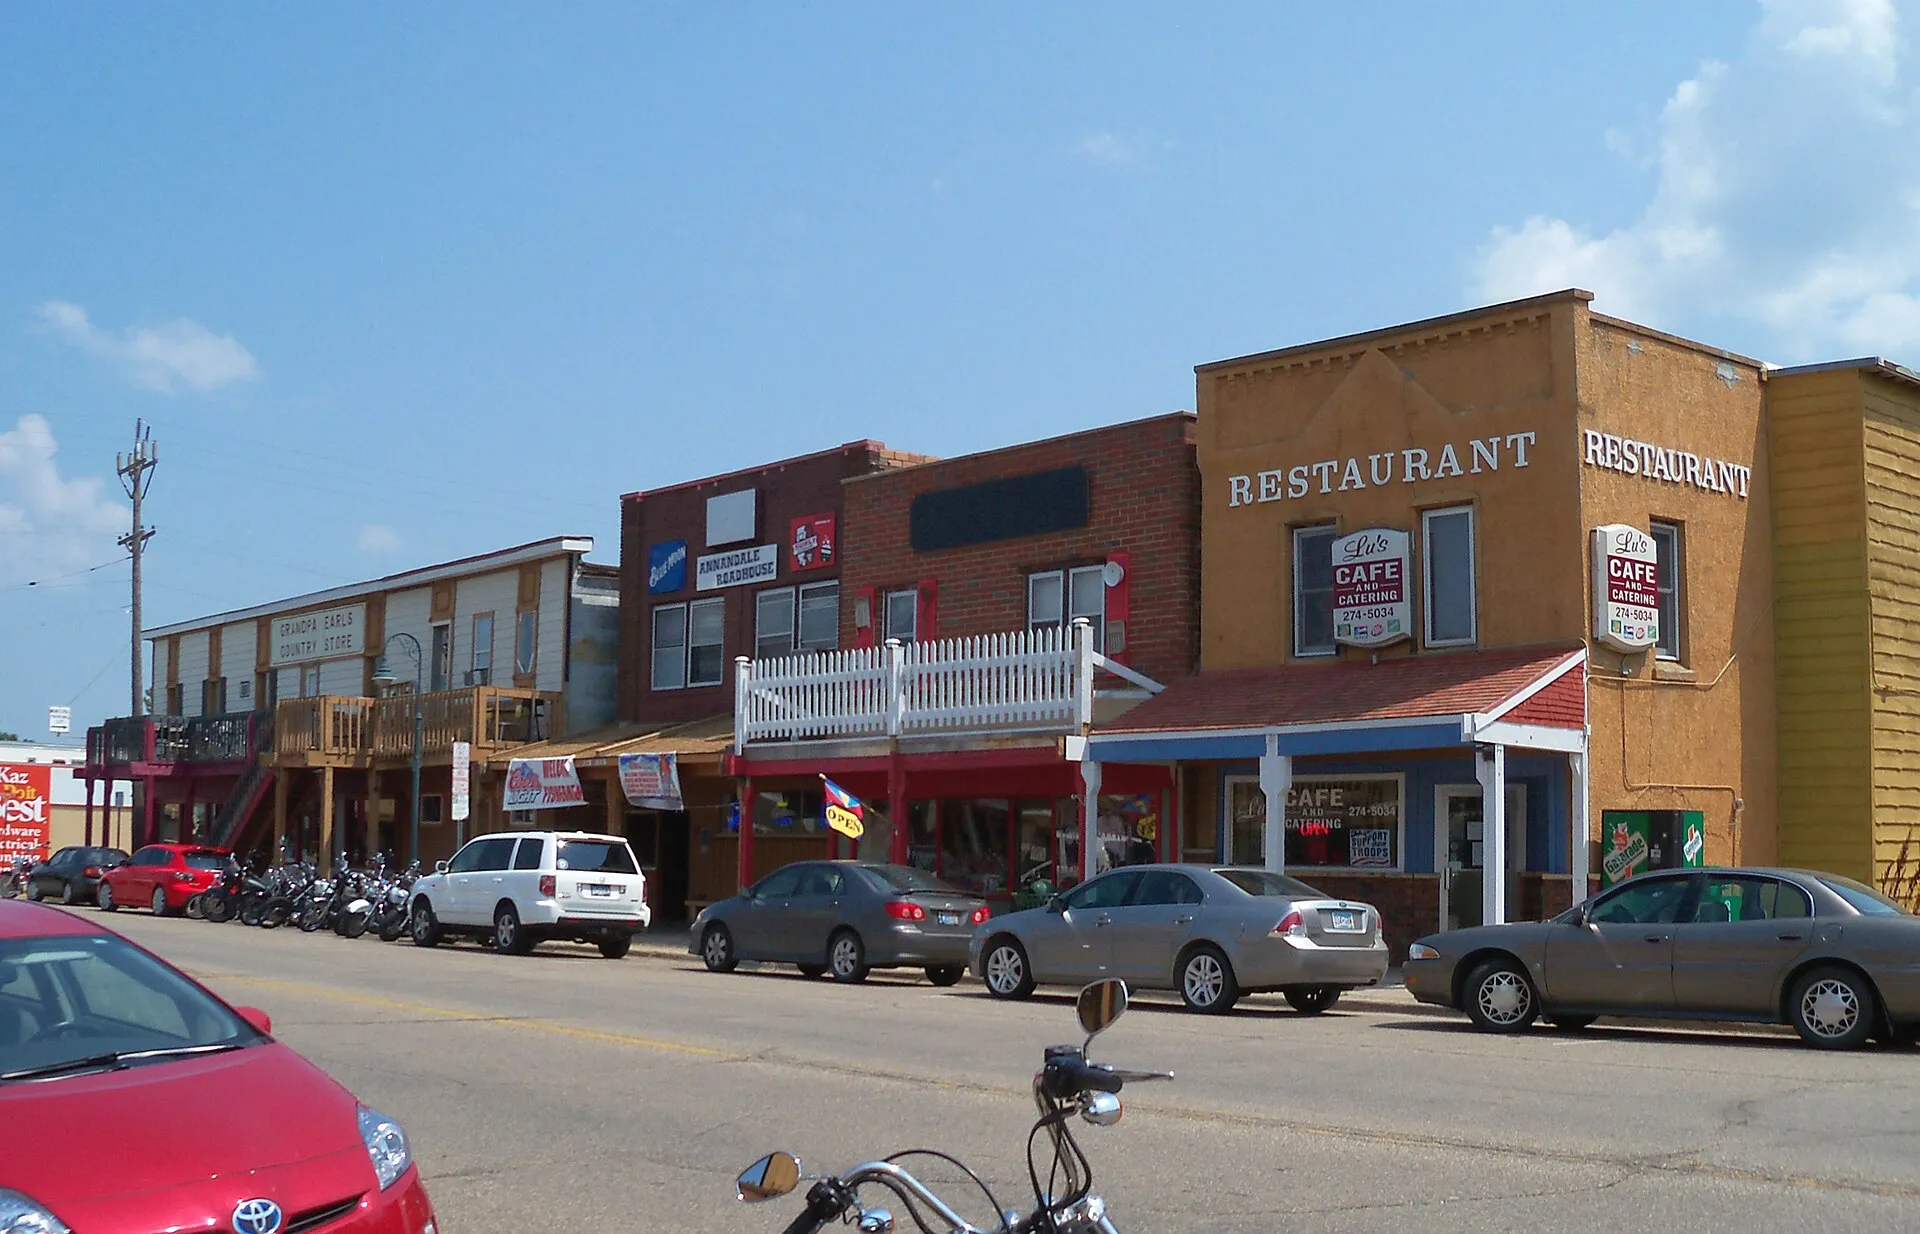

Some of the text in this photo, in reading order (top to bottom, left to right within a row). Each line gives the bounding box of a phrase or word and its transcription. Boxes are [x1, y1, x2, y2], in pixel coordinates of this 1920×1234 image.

[1228, 431, 1536, 507] RESTAURANT
[1584, 429, 1750, 499] RESTAURANT
[1342, 534, 1389, 562] Lu's
[1615, 531, 1648, 554] Lu's
[699, 549, 760, 575] ANNANDALE
[1335, 561, 1400, 585] CAFE
[1609, 559, 1656, 584] CAFE
[716, 562, 774, 587] ROADHOUSE
[1625, 580, 1642, 591] AND
[1338, 590, 1397, 606] CATERING
[1356, 582, 1379, 592] AND
[1612, 589, 1655, 606] CATERING
[280, 611, 353, 637] GRANDPA EARLS
[1343, 607, 1394, 622] 274-5034
[1615, 607, 1653, 621] 274-5034
[280, 634, 352, 658] COUNTRY STORE
[0, 766, 30, 784] Kaz
[1285, 788, 1344, 807] CAFE
[828, 809, 861, 833] OPEN
[1285, 818, 1342, 829] CATERING
[1302, 808, 1324, 816] AND
[1352, 847, 1389, 857] TROOPS
[1605, 838, 1645, 873] Gatorade
